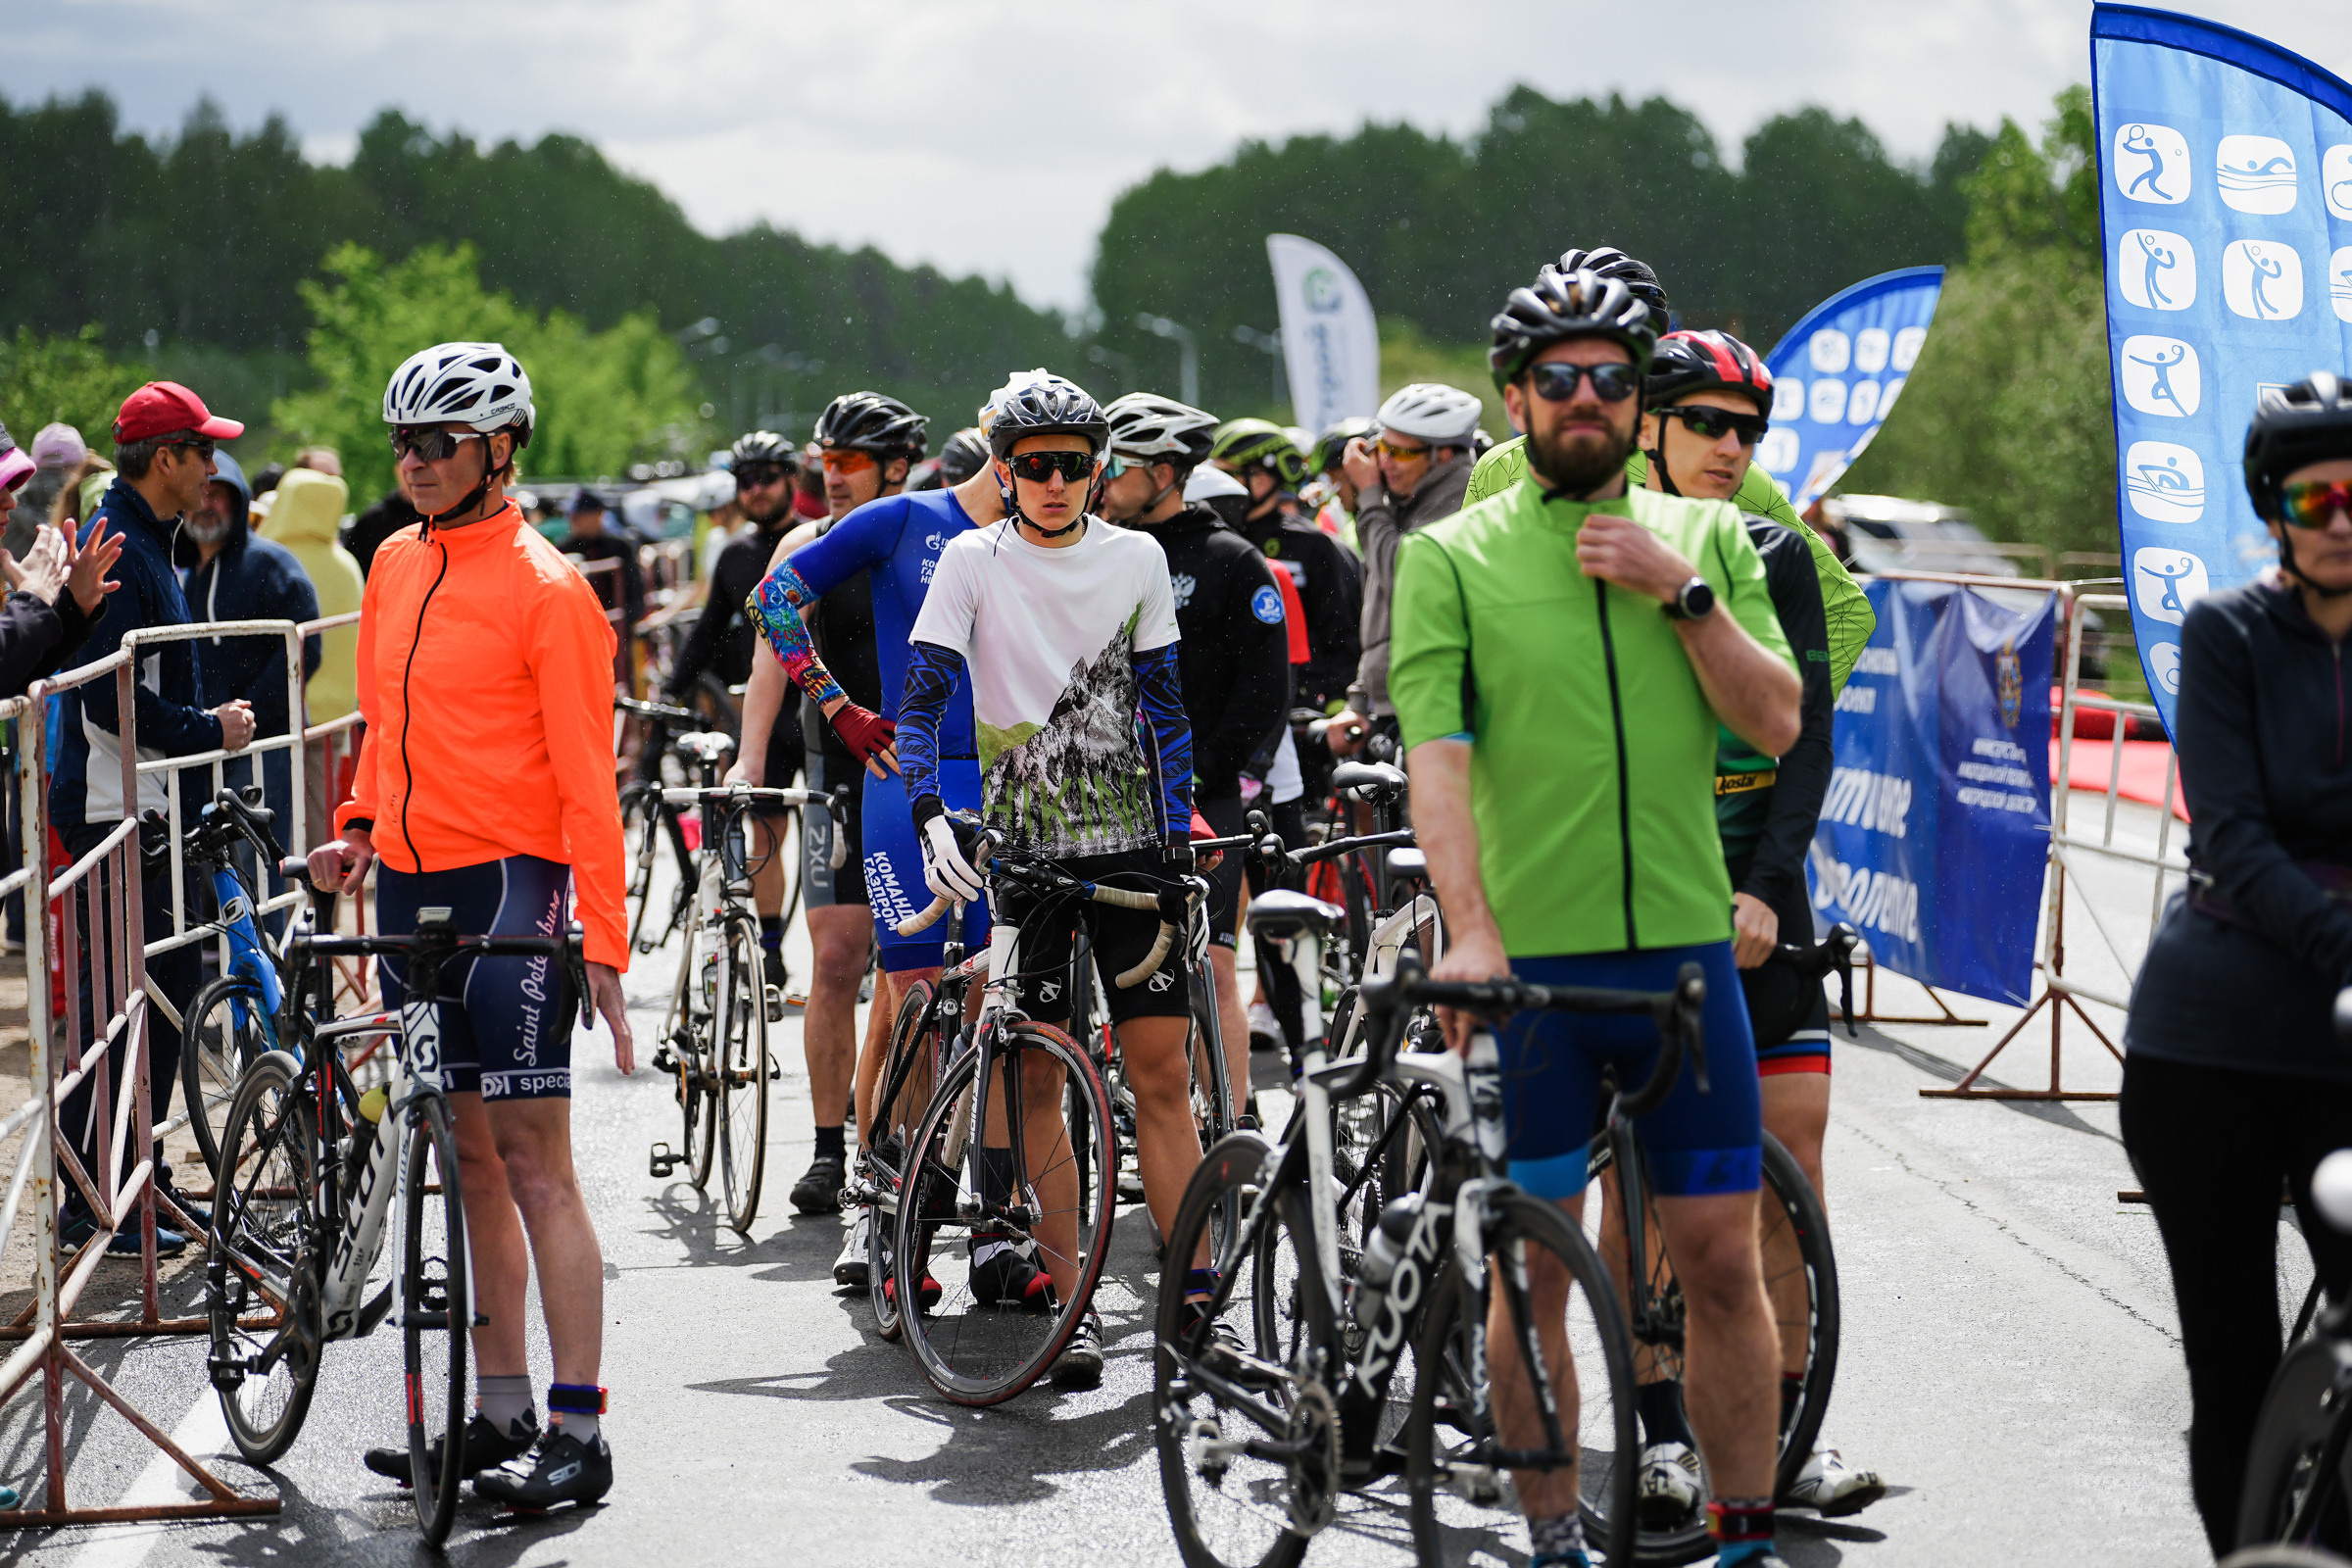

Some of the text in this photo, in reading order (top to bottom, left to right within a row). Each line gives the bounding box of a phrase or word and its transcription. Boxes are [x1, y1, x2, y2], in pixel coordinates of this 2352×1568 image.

[808, 825, 829, 888] 2XU
[863, 857, 899, 932] ГАЗПРОМ
[514, 890, 561, 1067] Saint Peteburg
[969, 1044, 983, 1145] MERIDA
[1356, 1200, 1454, 1398] KUOTA
[547, 1459, 582, 1487] SIDI
